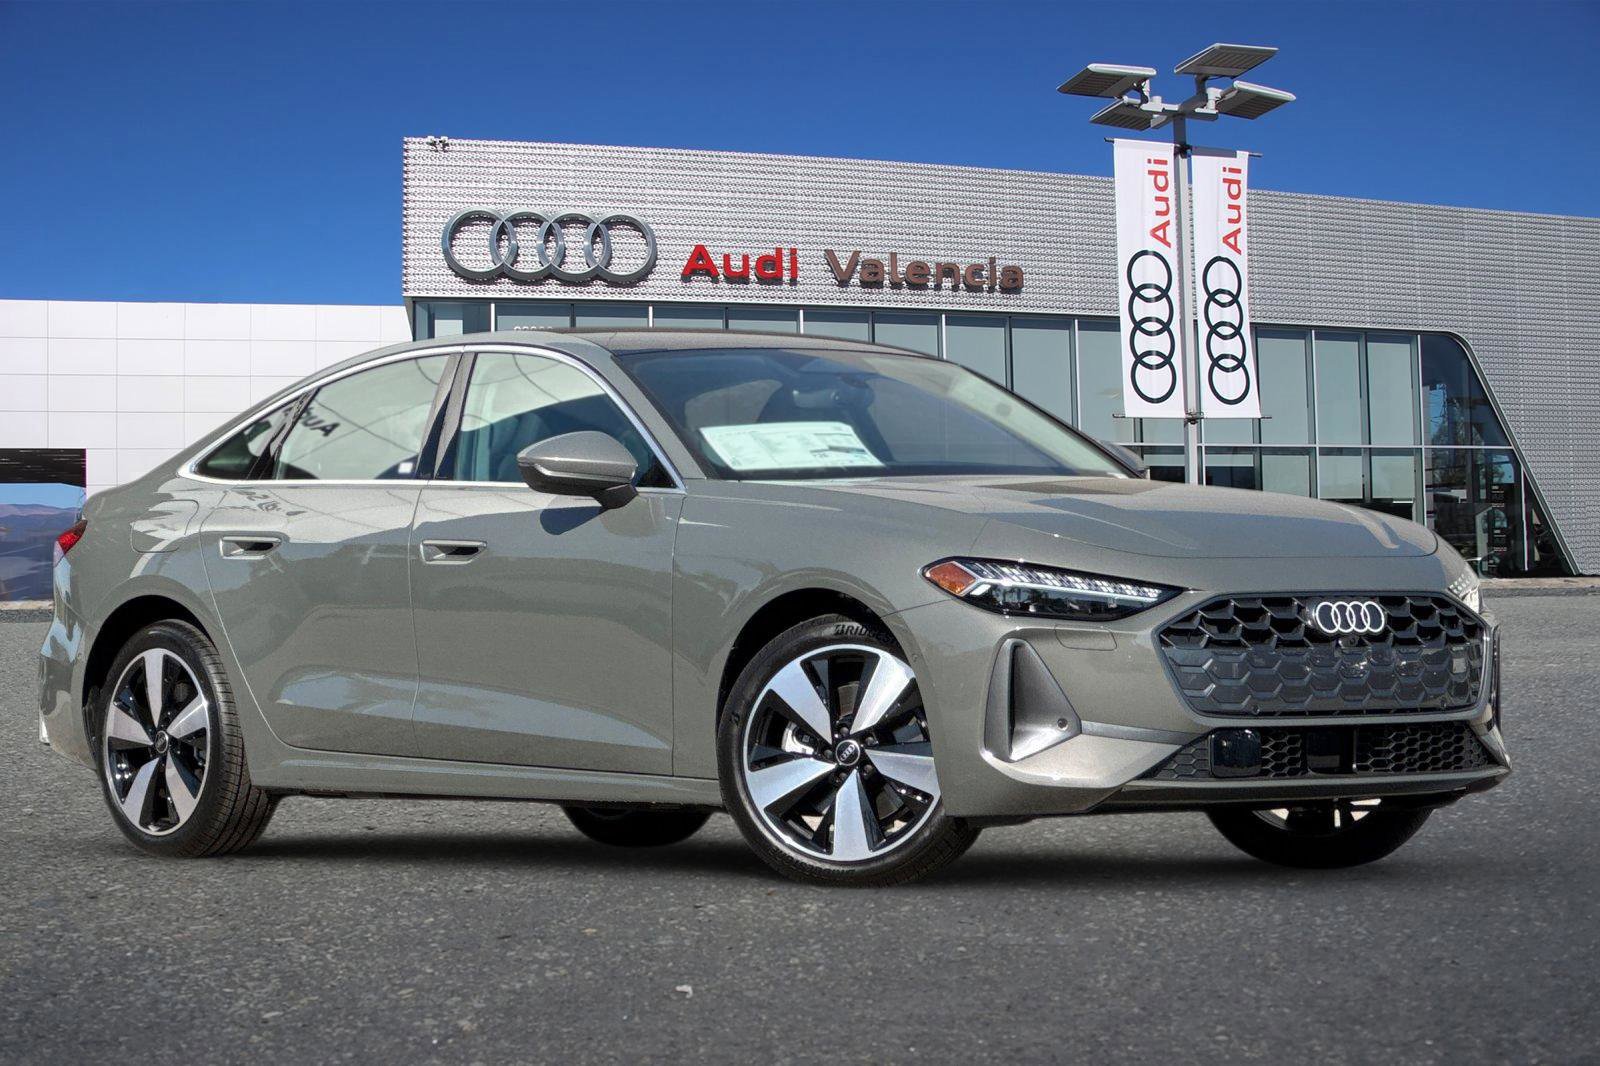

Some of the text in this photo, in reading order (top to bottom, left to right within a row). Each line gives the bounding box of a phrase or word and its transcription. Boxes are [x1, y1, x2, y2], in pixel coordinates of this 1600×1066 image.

[1148, 159, 1171, 247] Audi
[1222, 167, 1243, 254] Audi
[682, 244, 1025, 292] Audi Valencia
